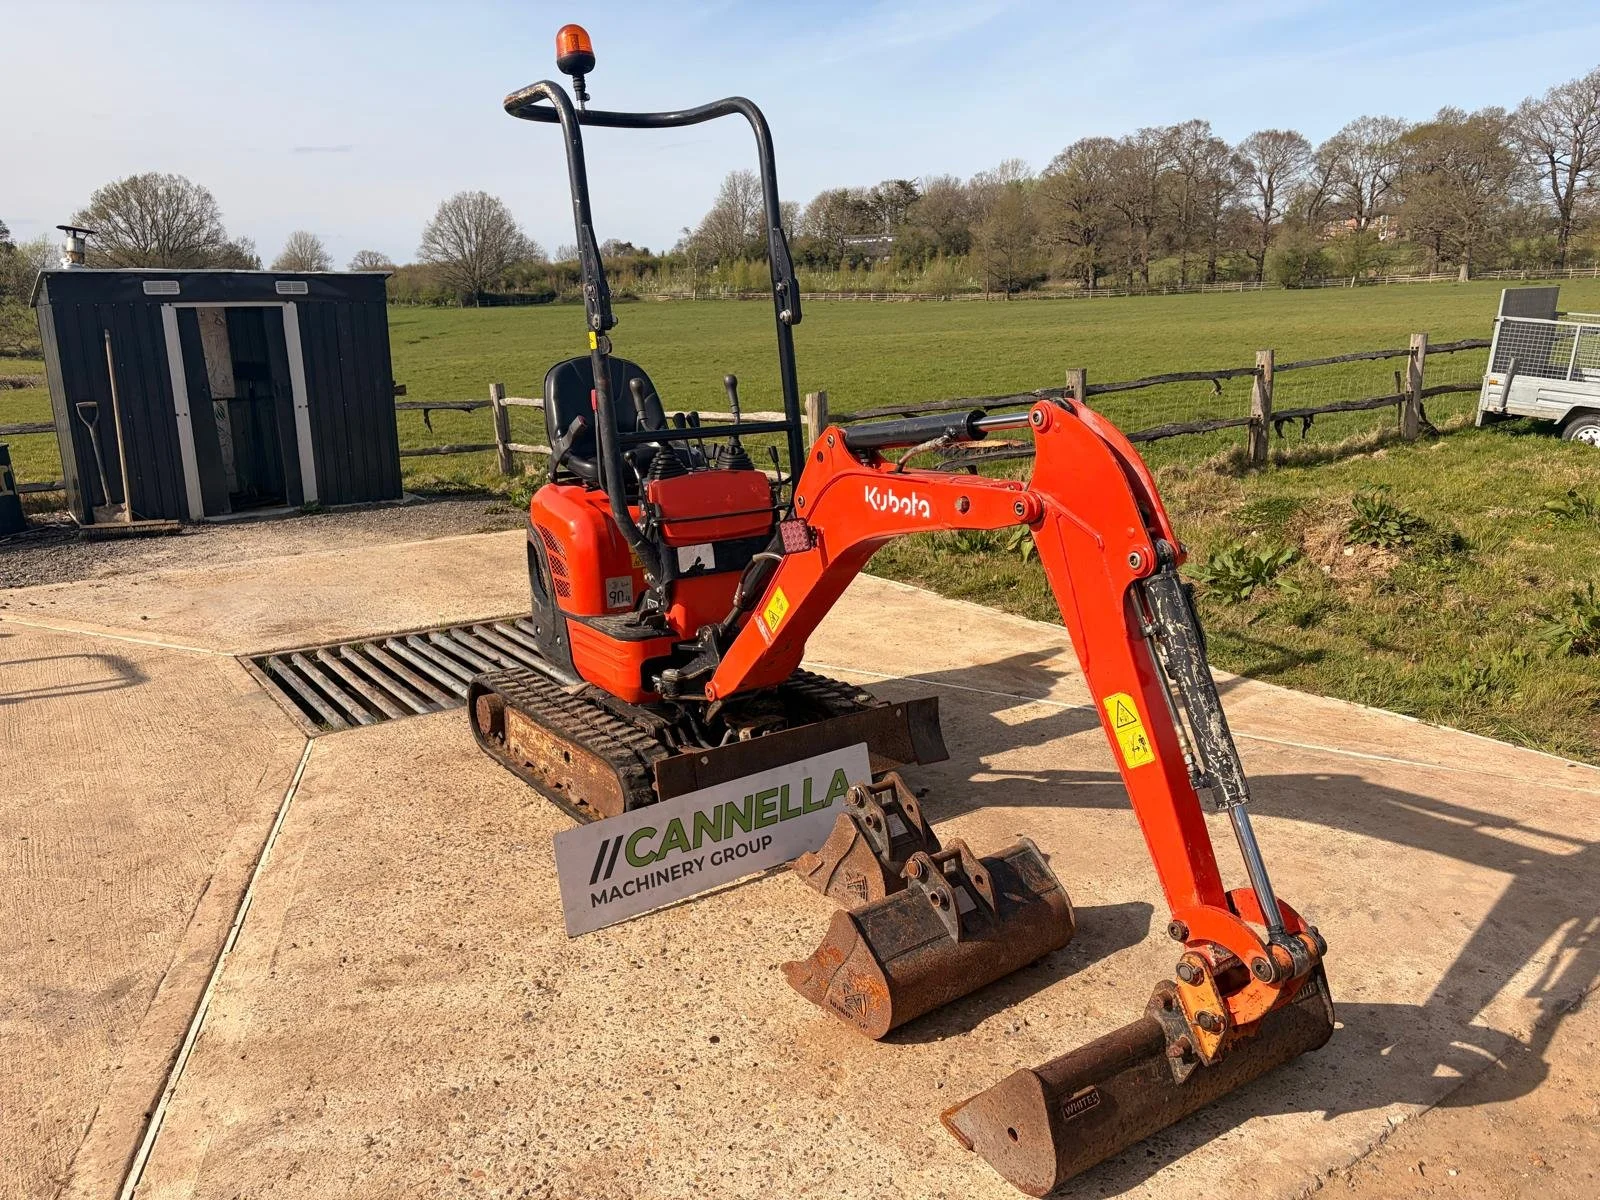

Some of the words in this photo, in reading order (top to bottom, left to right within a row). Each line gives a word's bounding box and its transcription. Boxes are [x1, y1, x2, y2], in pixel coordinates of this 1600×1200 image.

[864, 485, 930, 518] Kubota
[625, 768, 850, 868] CANNELLA
[590, 856, 705, 908] MACHINERY
[710, 835, 773, 867] GROUP
[1065, 1092, 1097, 1116] WHITES
